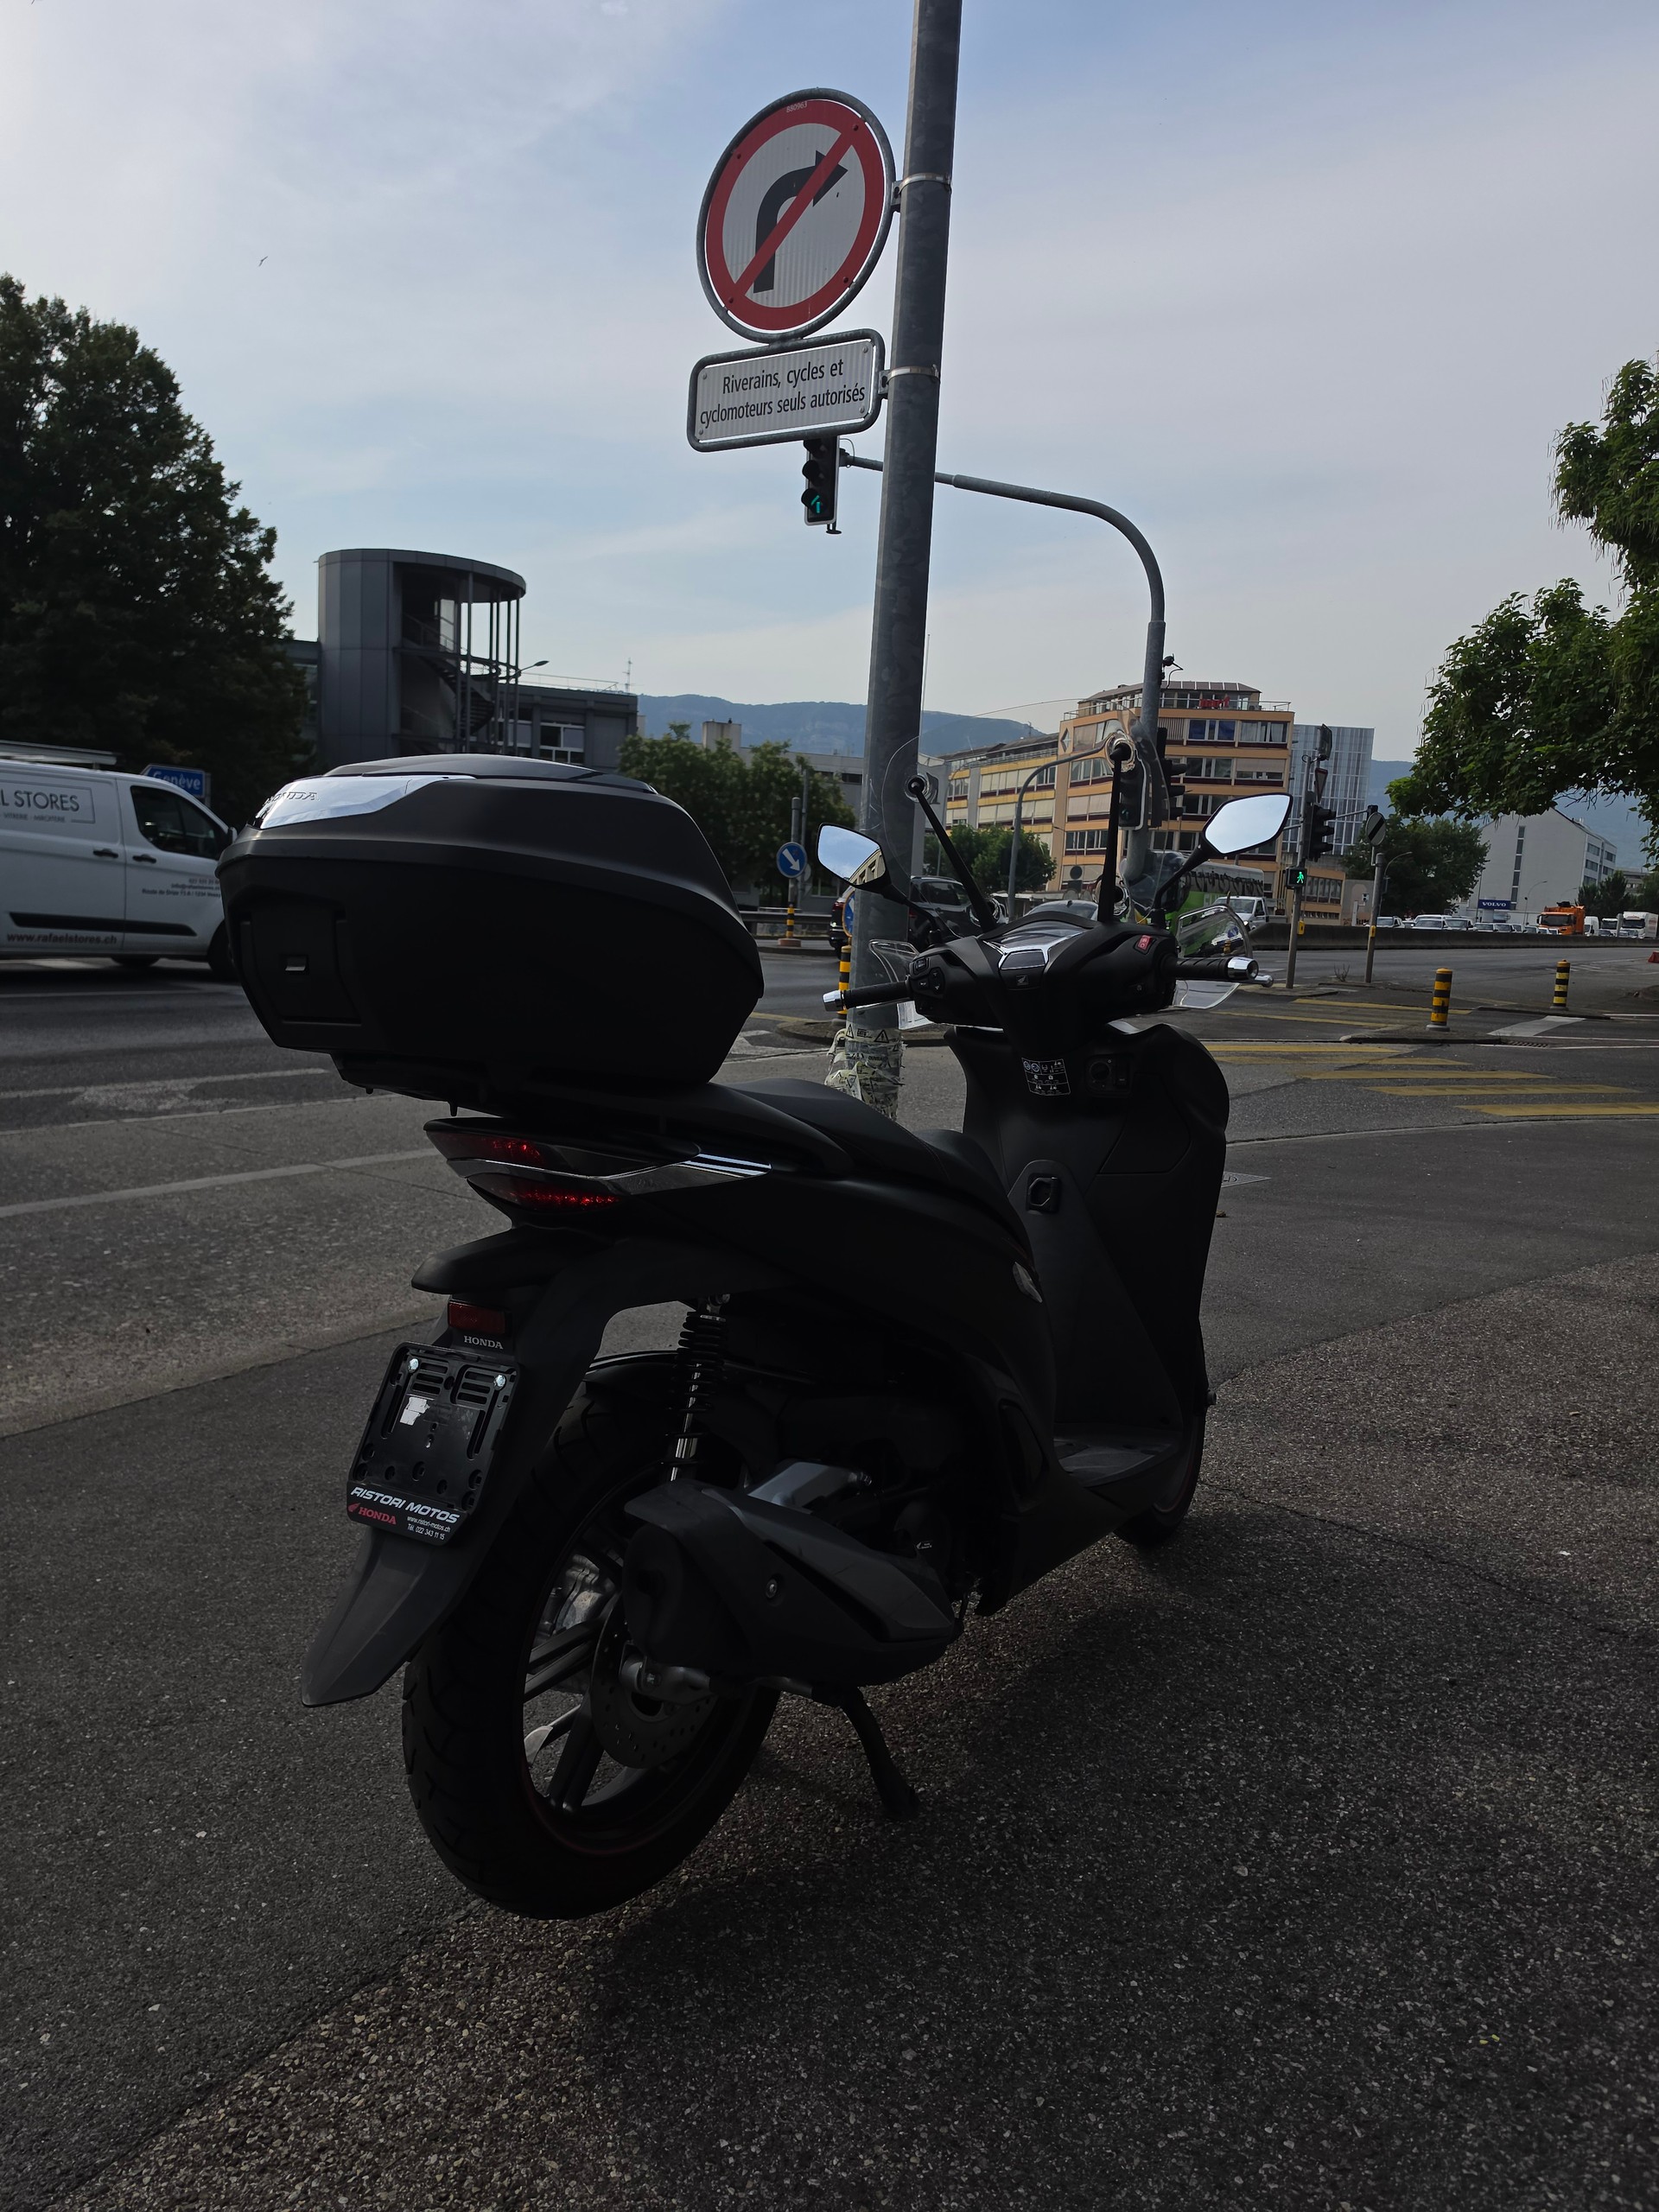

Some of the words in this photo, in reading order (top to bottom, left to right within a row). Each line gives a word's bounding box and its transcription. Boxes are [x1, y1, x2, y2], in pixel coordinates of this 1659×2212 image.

[722, 370, 781, 394] Riverains,
[786, 362, 825, 388] cycles
[830, 359, 844, 378] et
[700, 400, 773, 429] cyclomoteurs
[777, 391, 806, 413] seuls
[810, 383, 865, 408] autorisés
[14, 790, 80, 812] STORES
[7, 932, 118, 944] www.rafaelstores.ch
[463, 1335, 504, 1350] HONDA
[350, 1486, 407, 1510] RISTORI
[405, 1502, 461, 1524] MOTOS
[358, 1506, 397, 1525] HONDA
[407, 1516, 450, 1532] www.ristori-motos.ch
